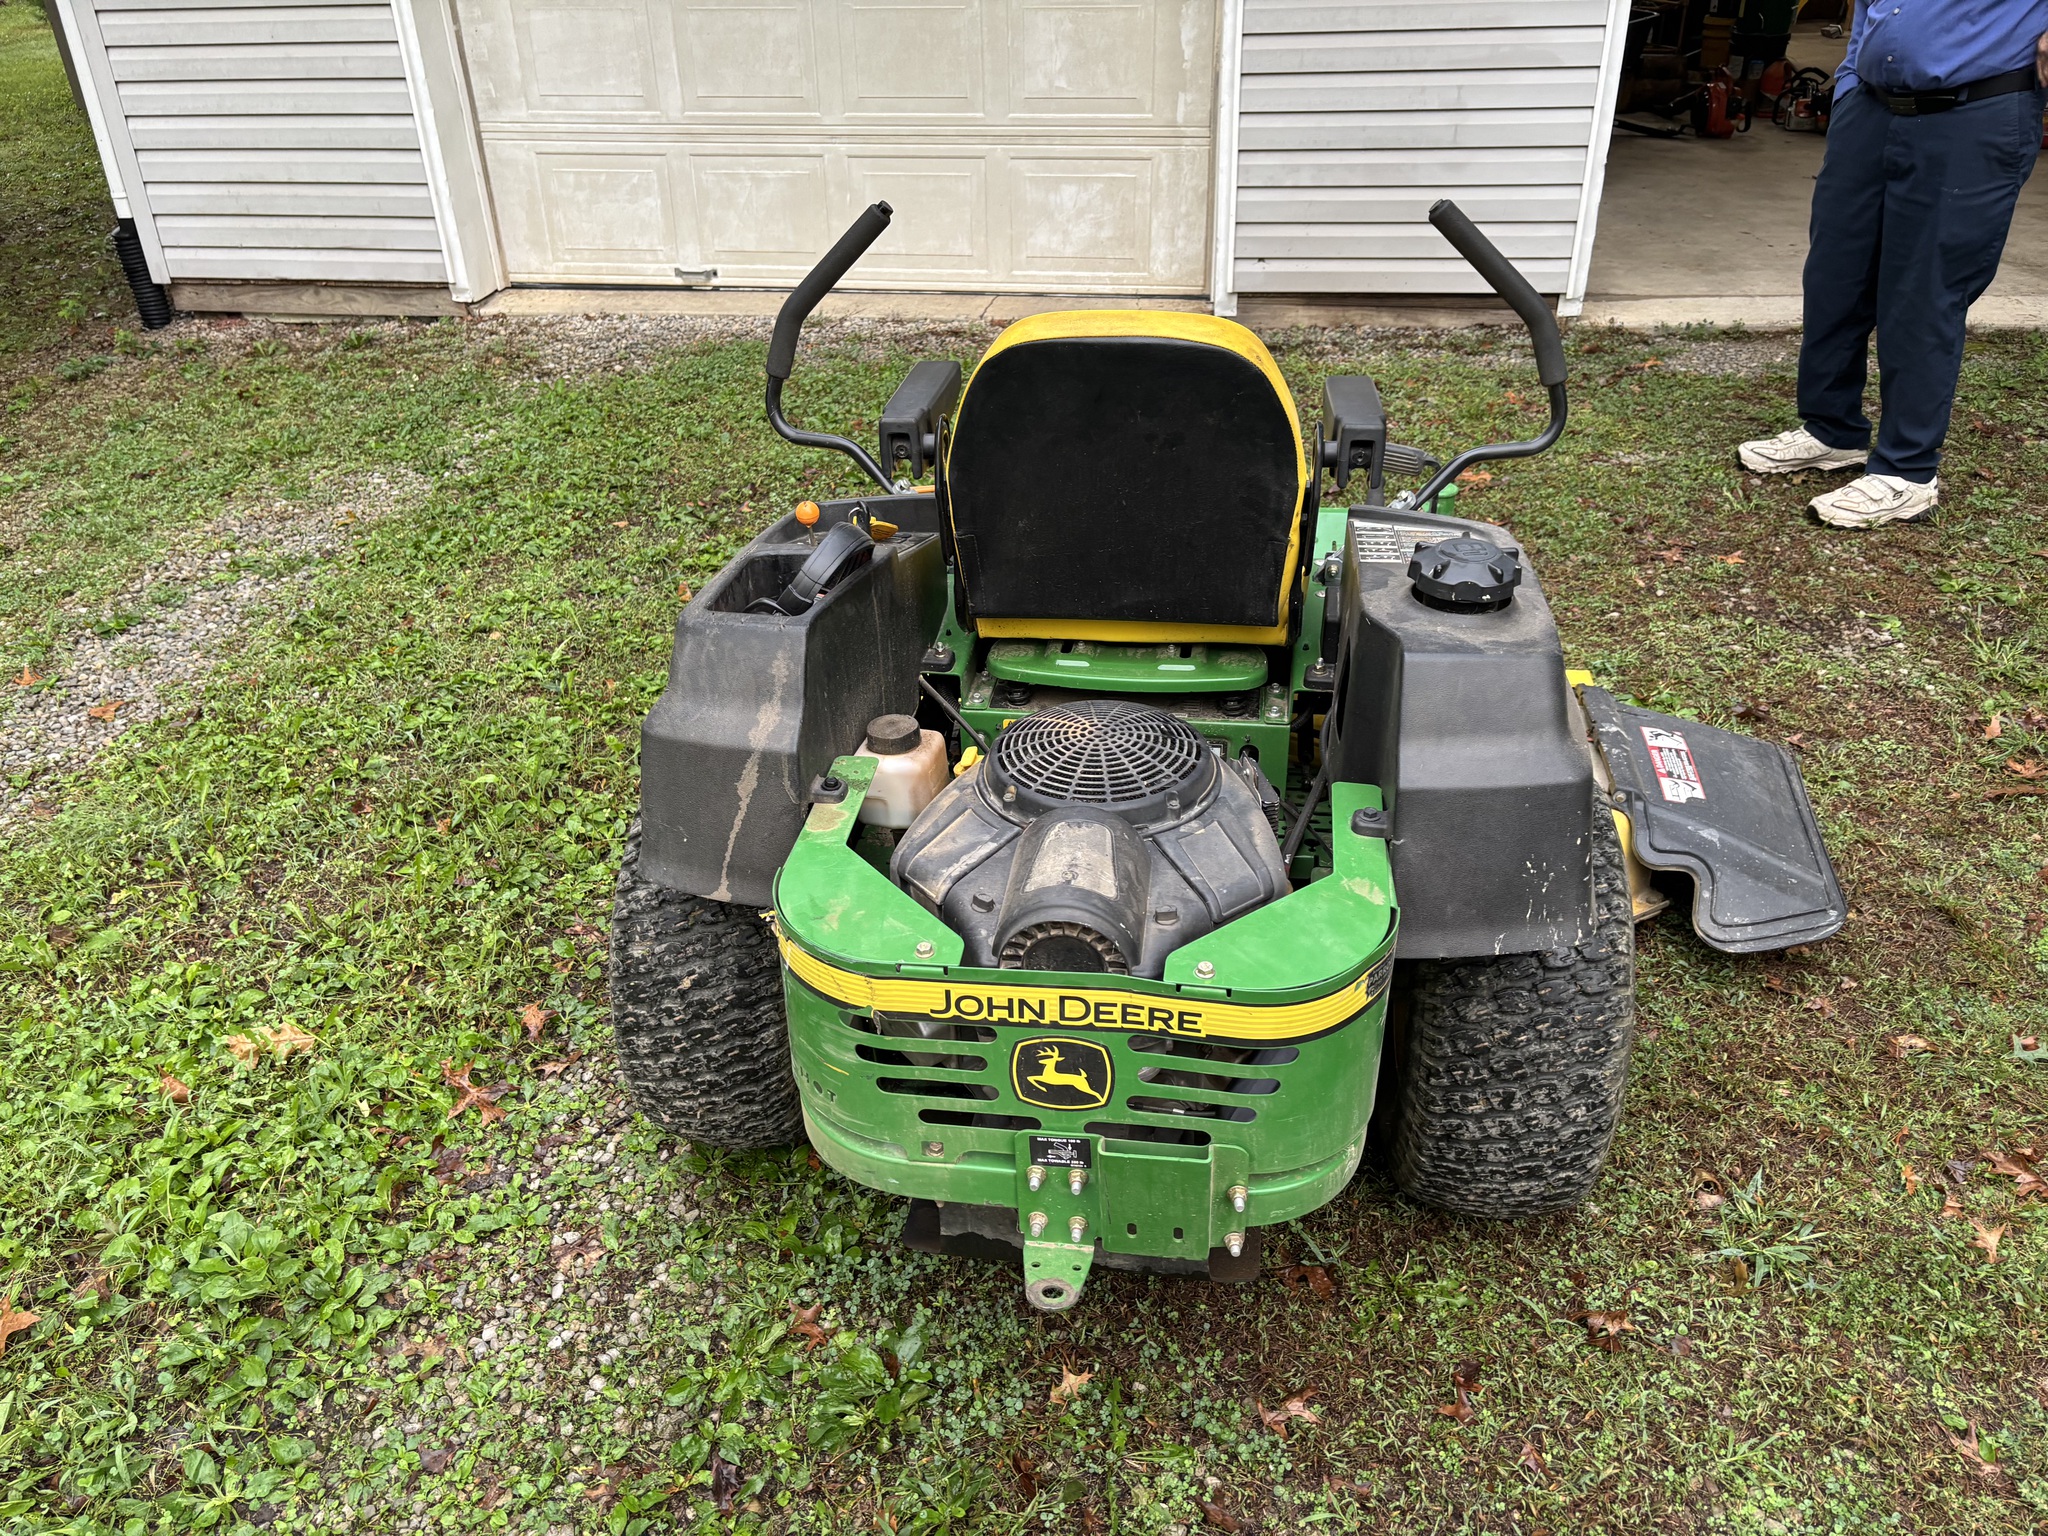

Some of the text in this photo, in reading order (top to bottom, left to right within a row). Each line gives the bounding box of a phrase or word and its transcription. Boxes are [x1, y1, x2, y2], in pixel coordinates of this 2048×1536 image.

[1650, 749, 1666, 769] DANGER
[930, 989, 1203, 1033] JOHN DEERE
[799, 1066, 837, 1103] HOT
